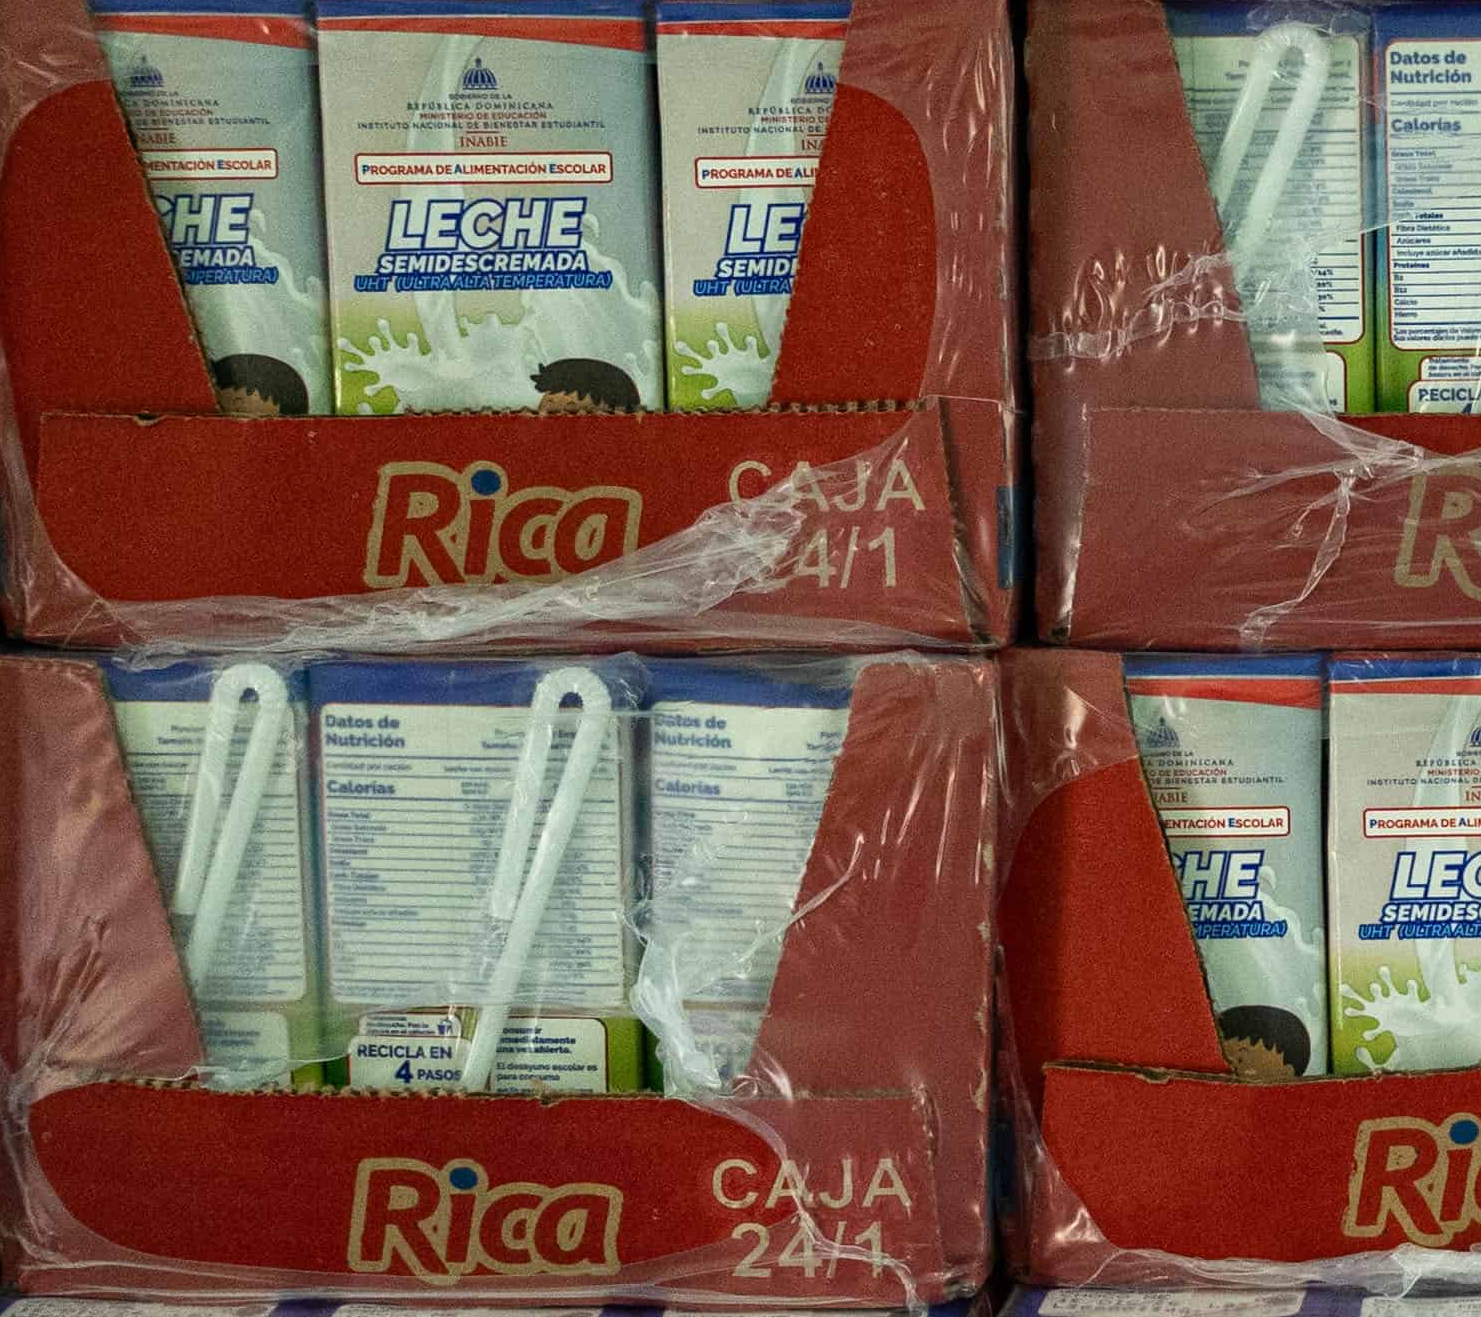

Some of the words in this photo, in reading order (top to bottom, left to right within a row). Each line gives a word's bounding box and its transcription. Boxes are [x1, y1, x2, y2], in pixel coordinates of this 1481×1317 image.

[1390, 51, 1440, 65] Datos
[1444, 50, 1466, 64] de
[1390, 69, 1472, 84] Nutrición
[459, 136, 507, 147] INABIE
[362, 164, 434, 176] PROGRAMA
[436, 164, 452, 175] DE
[454, 162, 547, 175] ALIMENTACIÓN
[549, 164, 606, 174] ESCOLAR
[385, 197, 588, 251] LECHE
[377, 251, 588, 274] SEMIDESCREMADA
[727, 461, 925, 511] CAJA
[366, 461, 641, 597] Rica
[1370, 818, 1439, 830] PROGRAMA
[1441, 818, 1456, 828] DE
[712, 1158, 910, 1209] CAJA
[350, 1157, 622, 1282] Rica
[732, 1222, 885, 1278] 24/1
